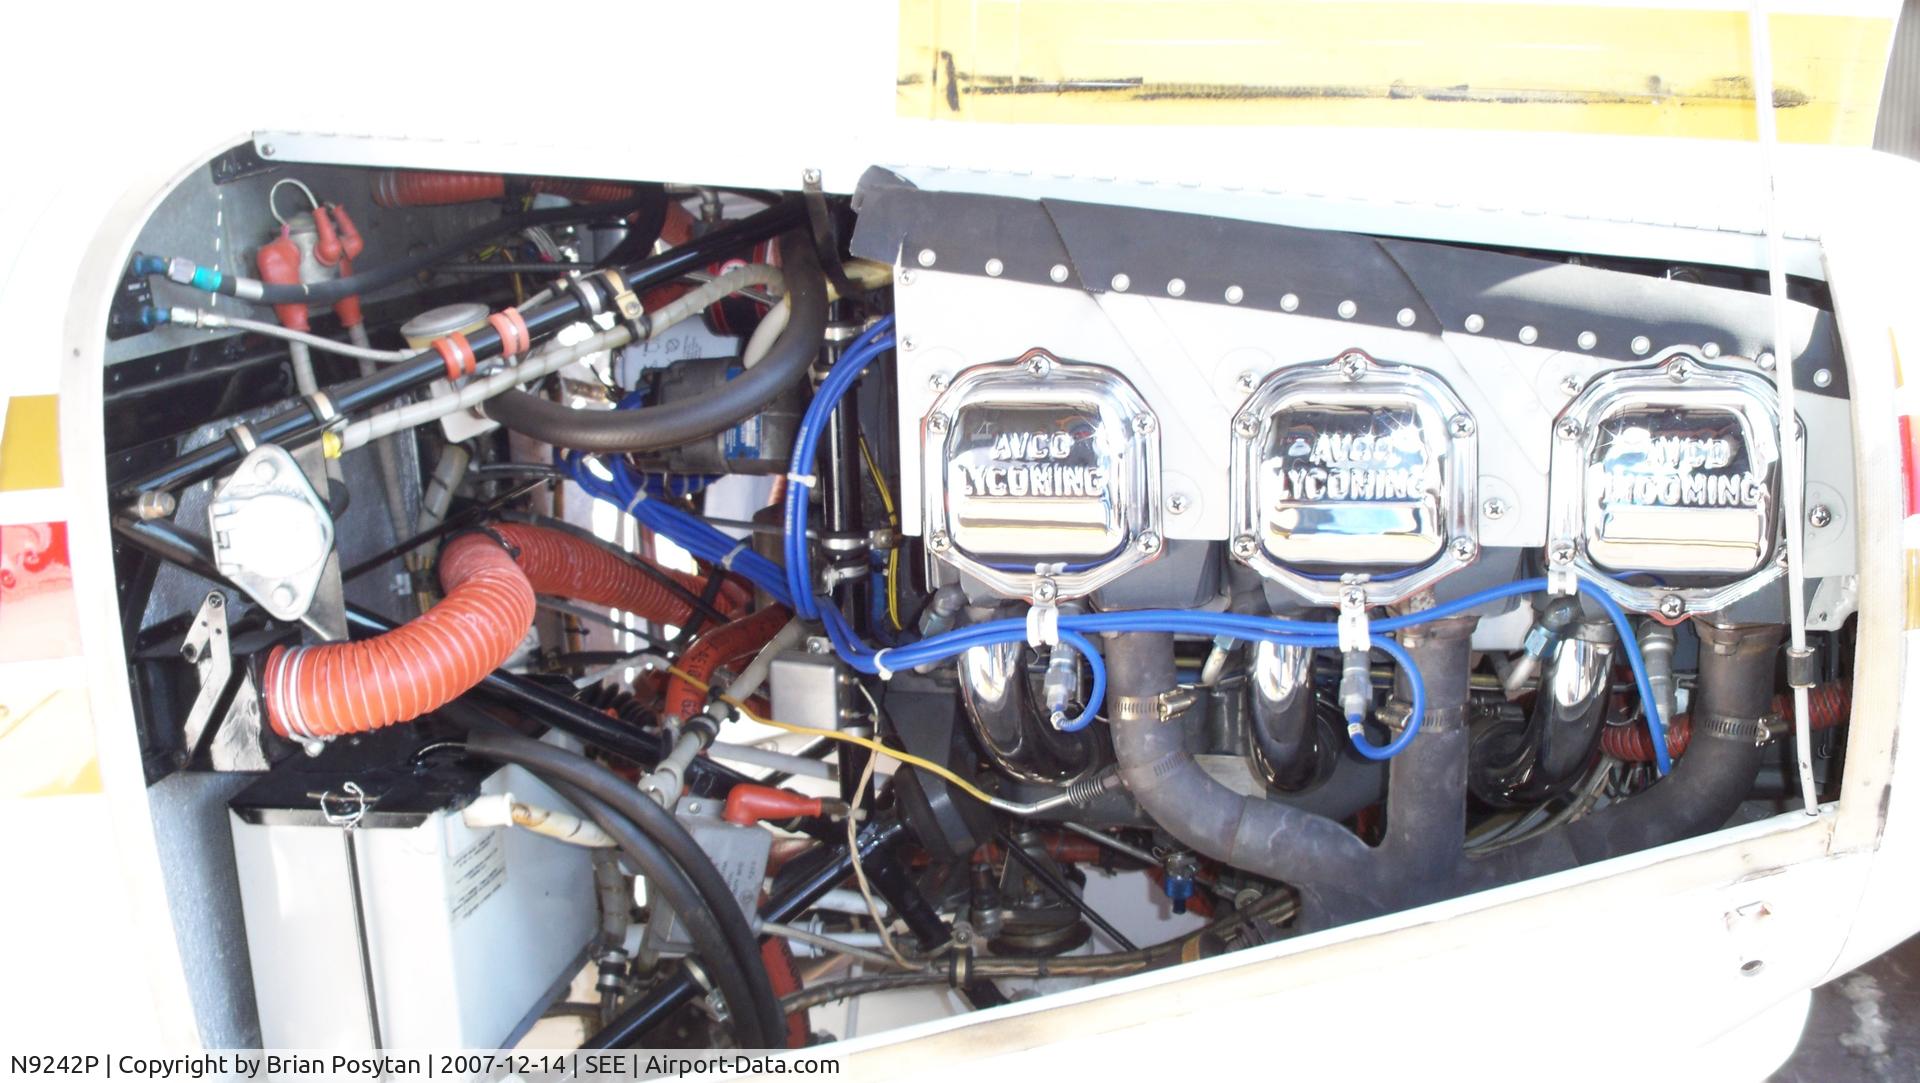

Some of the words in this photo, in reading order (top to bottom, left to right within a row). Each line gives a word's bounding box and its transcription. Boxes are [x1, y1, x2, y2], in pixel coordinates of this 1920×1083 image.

[993, 431, 1071, 461] AVCO
[961, 464, 1104, 497] LYCOMING
[1278, 467, 1424, 500] LYCOMING
